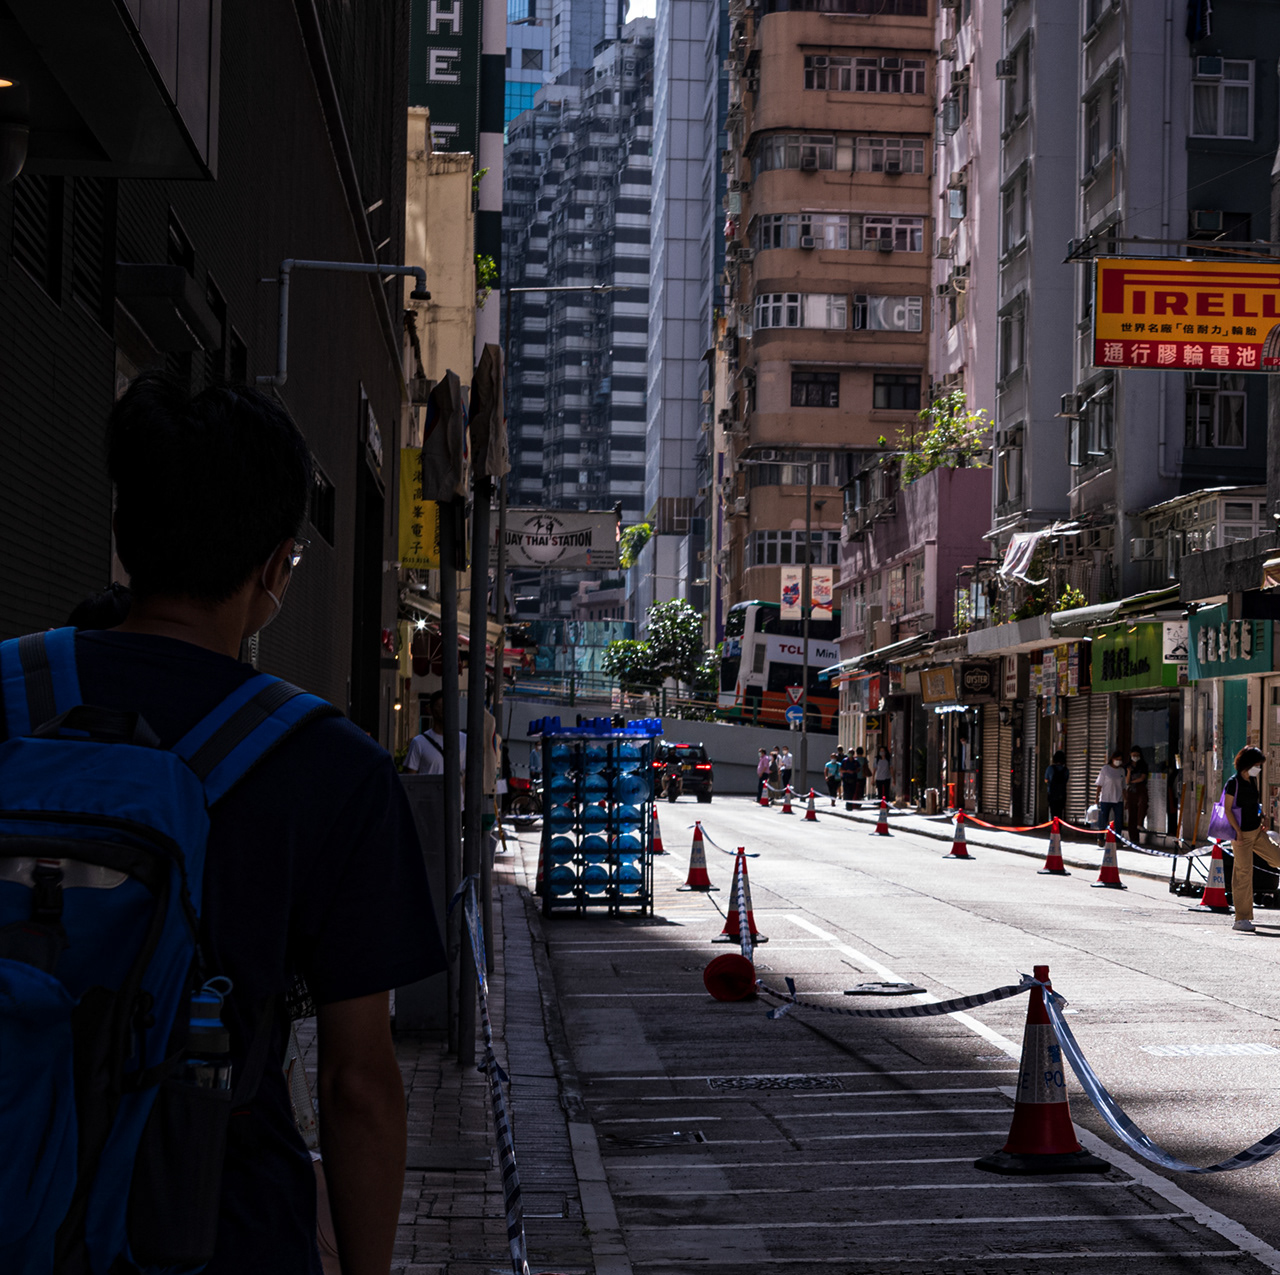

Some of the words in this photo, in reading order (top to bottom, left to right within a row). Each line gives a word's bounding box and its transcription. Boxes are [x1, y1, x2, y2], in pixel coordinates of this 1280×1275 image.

[1103, 341, 1257, 368] 通行膠輪電池
[495, 530, 521, 546] UAY
[526, 535, 549, 546] THAI
[552, 531, 592, 547] STATION
[779, 644, 804, 655] TCL
[815, 648, 837, 659] Mini
[966, 675, 988, 684] OYSTER
